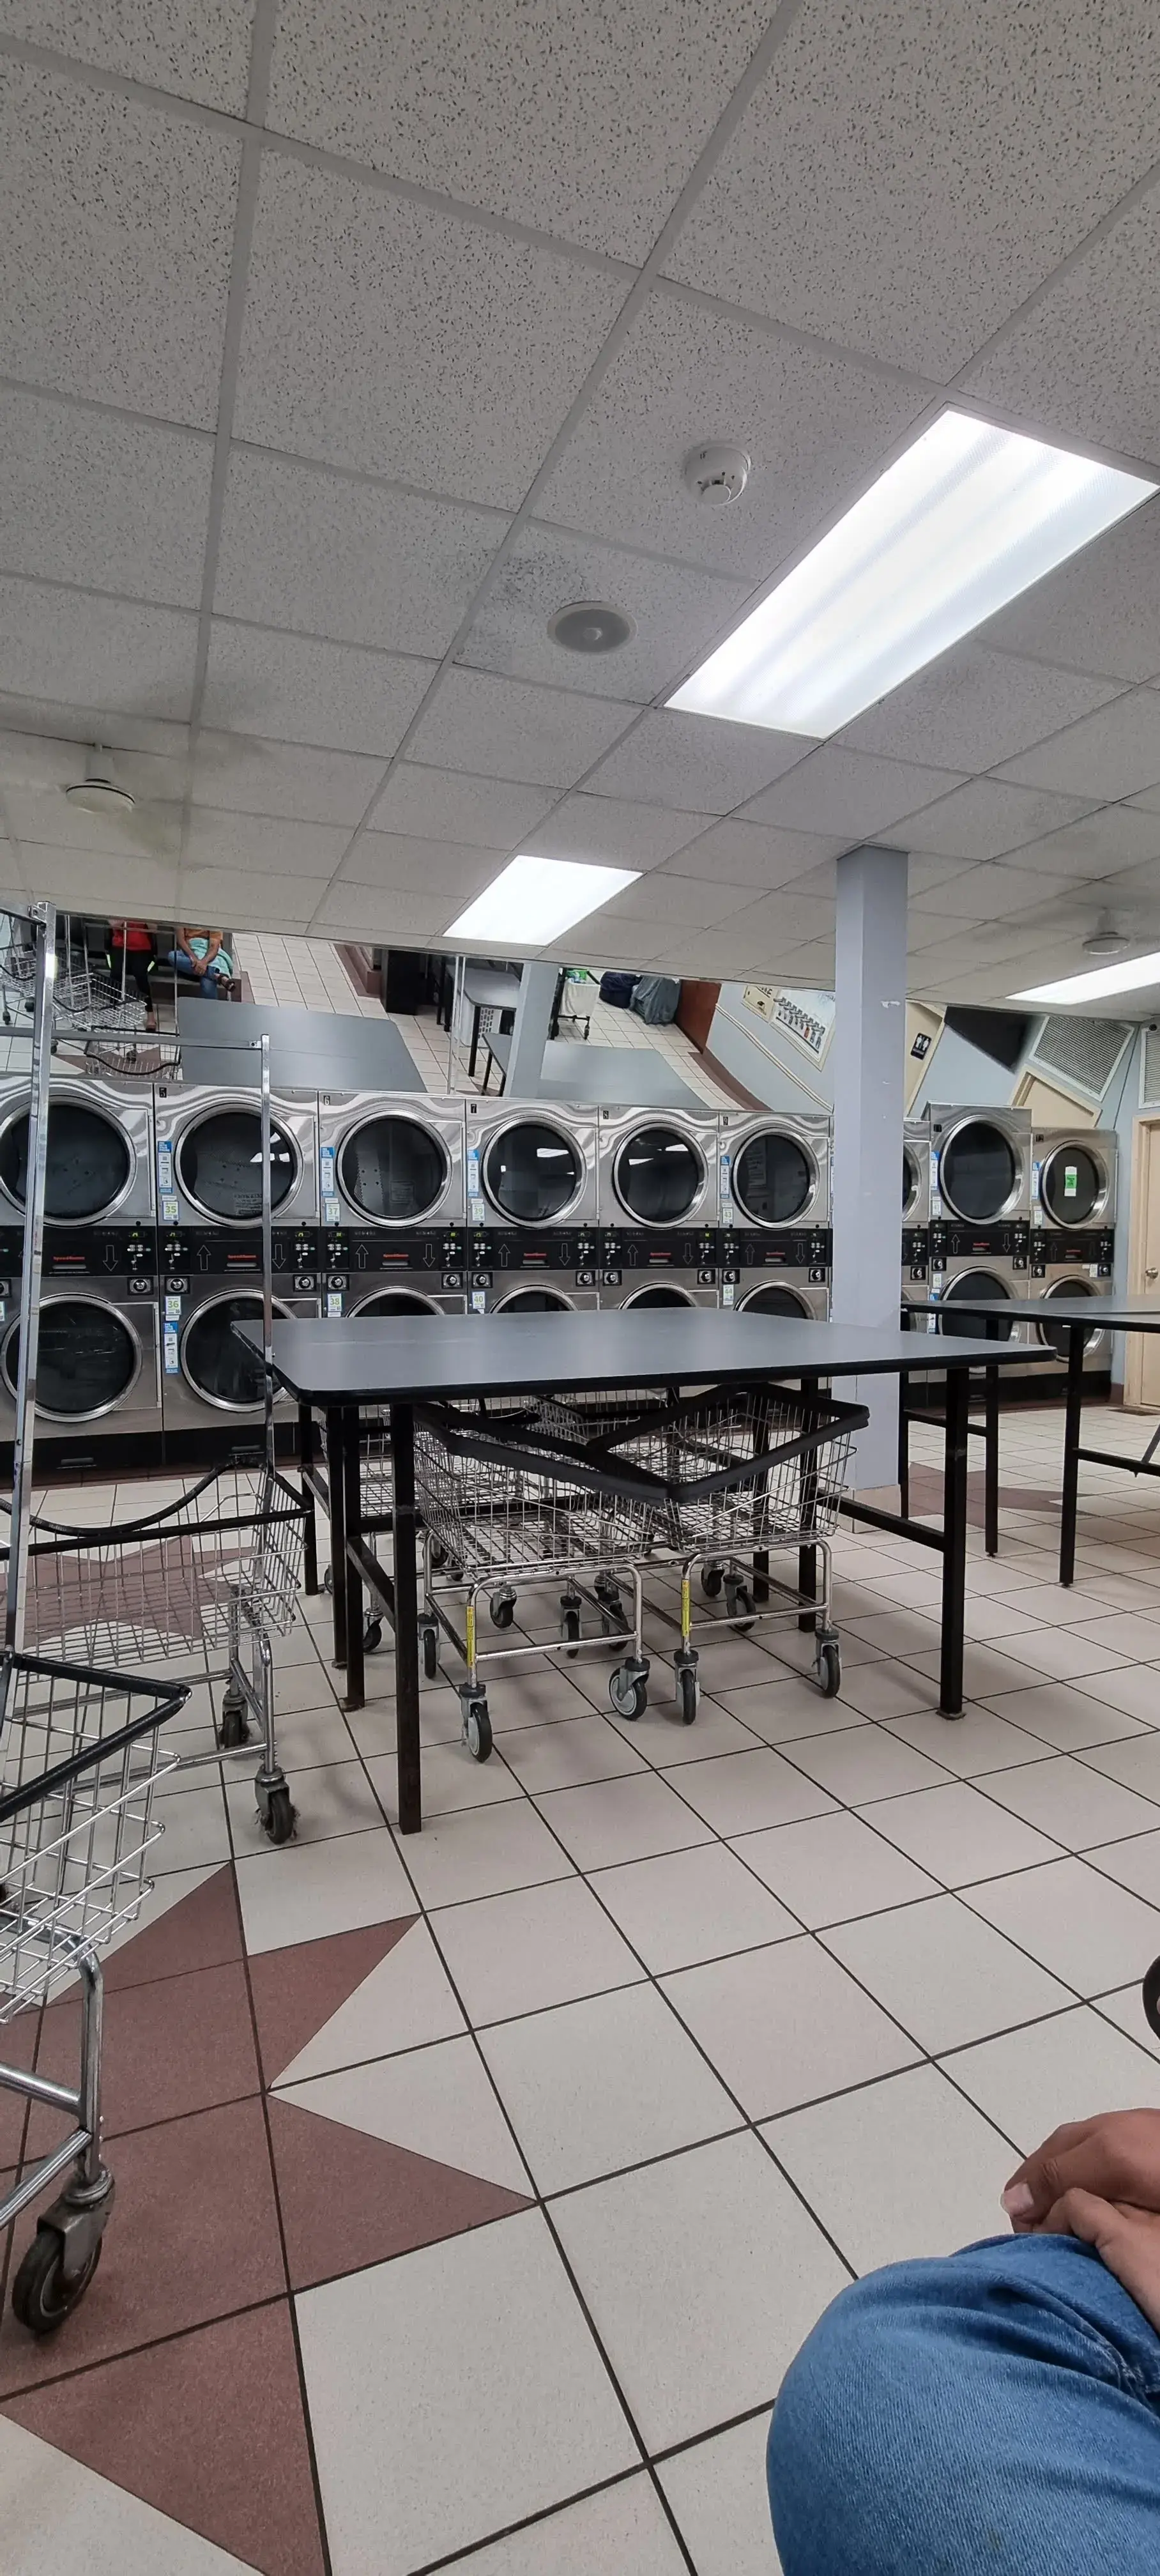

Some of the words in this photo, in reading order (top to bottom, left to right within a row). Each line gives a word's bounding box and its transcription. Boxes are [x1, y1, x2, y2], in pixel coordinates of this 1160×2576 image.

[160, 1087, 166, 1098] 5
[324, 1096, 330, 1105] 6
[472, 1104, 477, 1112] 7
[604, 1111, 608, 1119] 8
[165, 1206, 176, 1214] 35
[167, 1300, 179, 1308] 36
